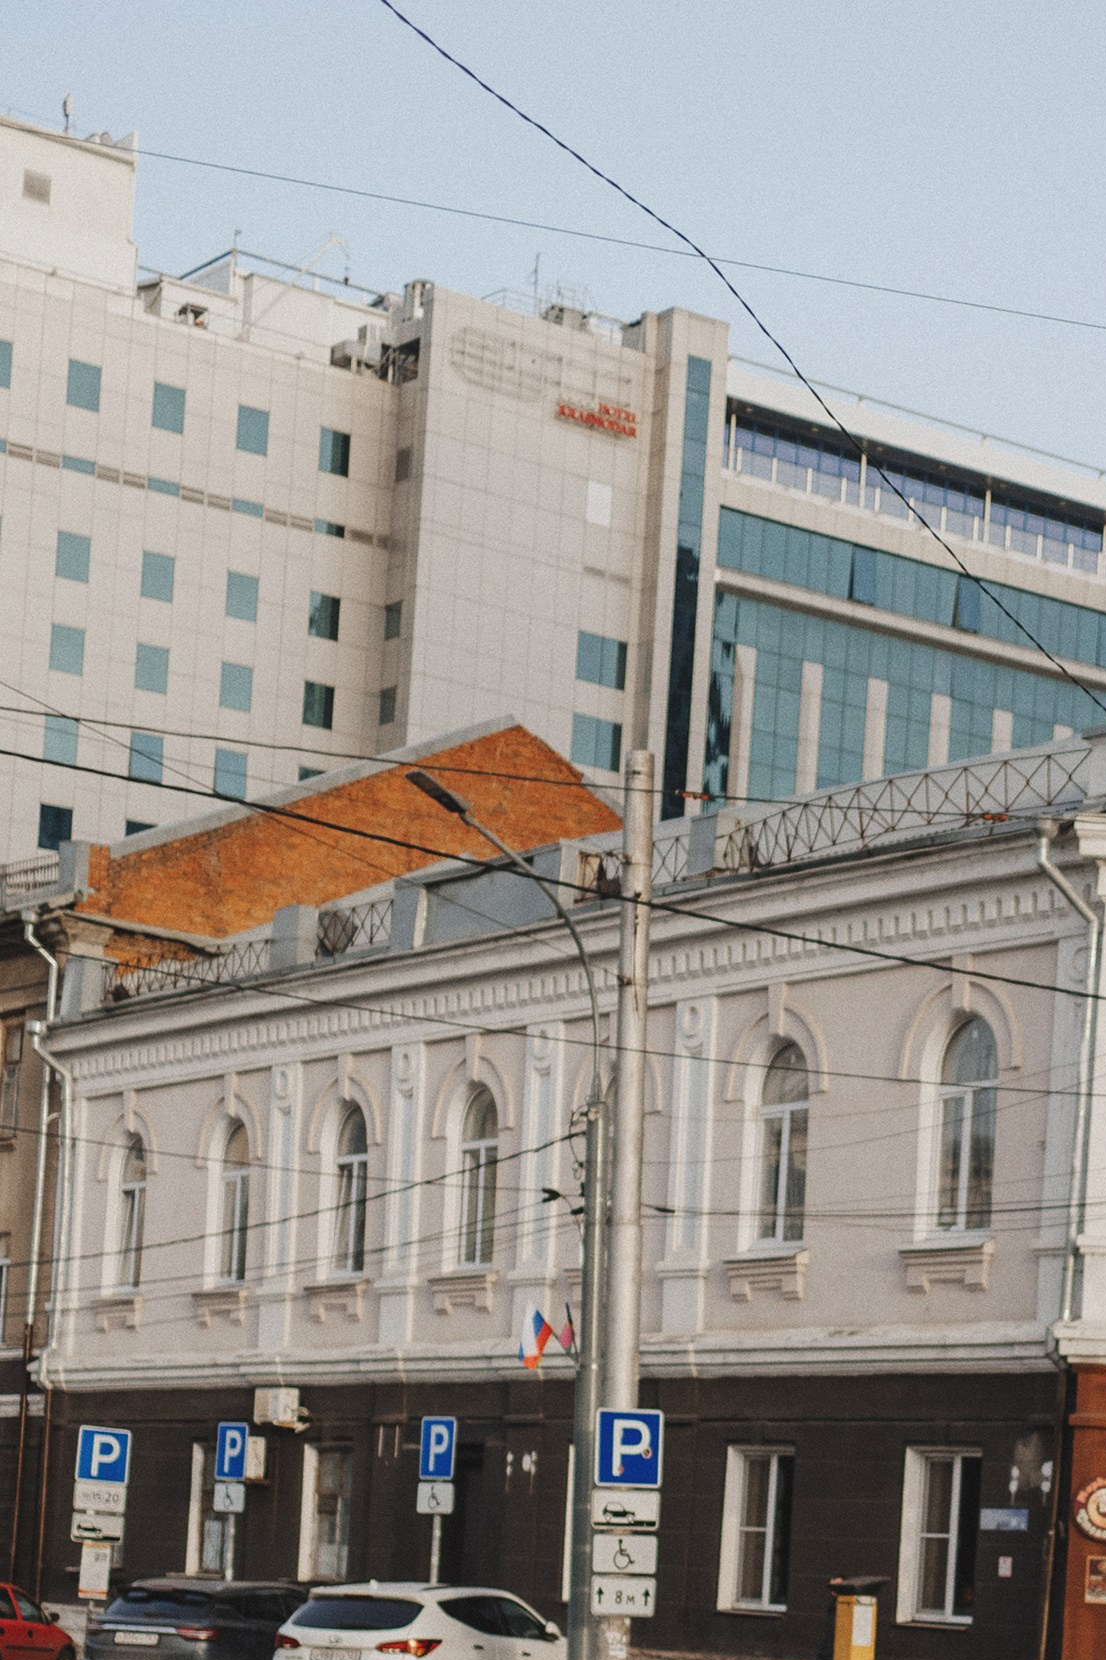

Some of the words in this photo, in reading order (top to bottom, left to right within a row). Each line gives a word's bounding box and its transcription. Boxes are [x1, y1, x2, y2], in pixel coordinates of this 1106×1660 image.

[91, 1434, 121, 1477] P
[224, 1430, 242, 1474] P
[430, 1424, 449, 1472] P
[612, 1419, 652, 1477] P
[614, 1590, 624, 1605] 8
